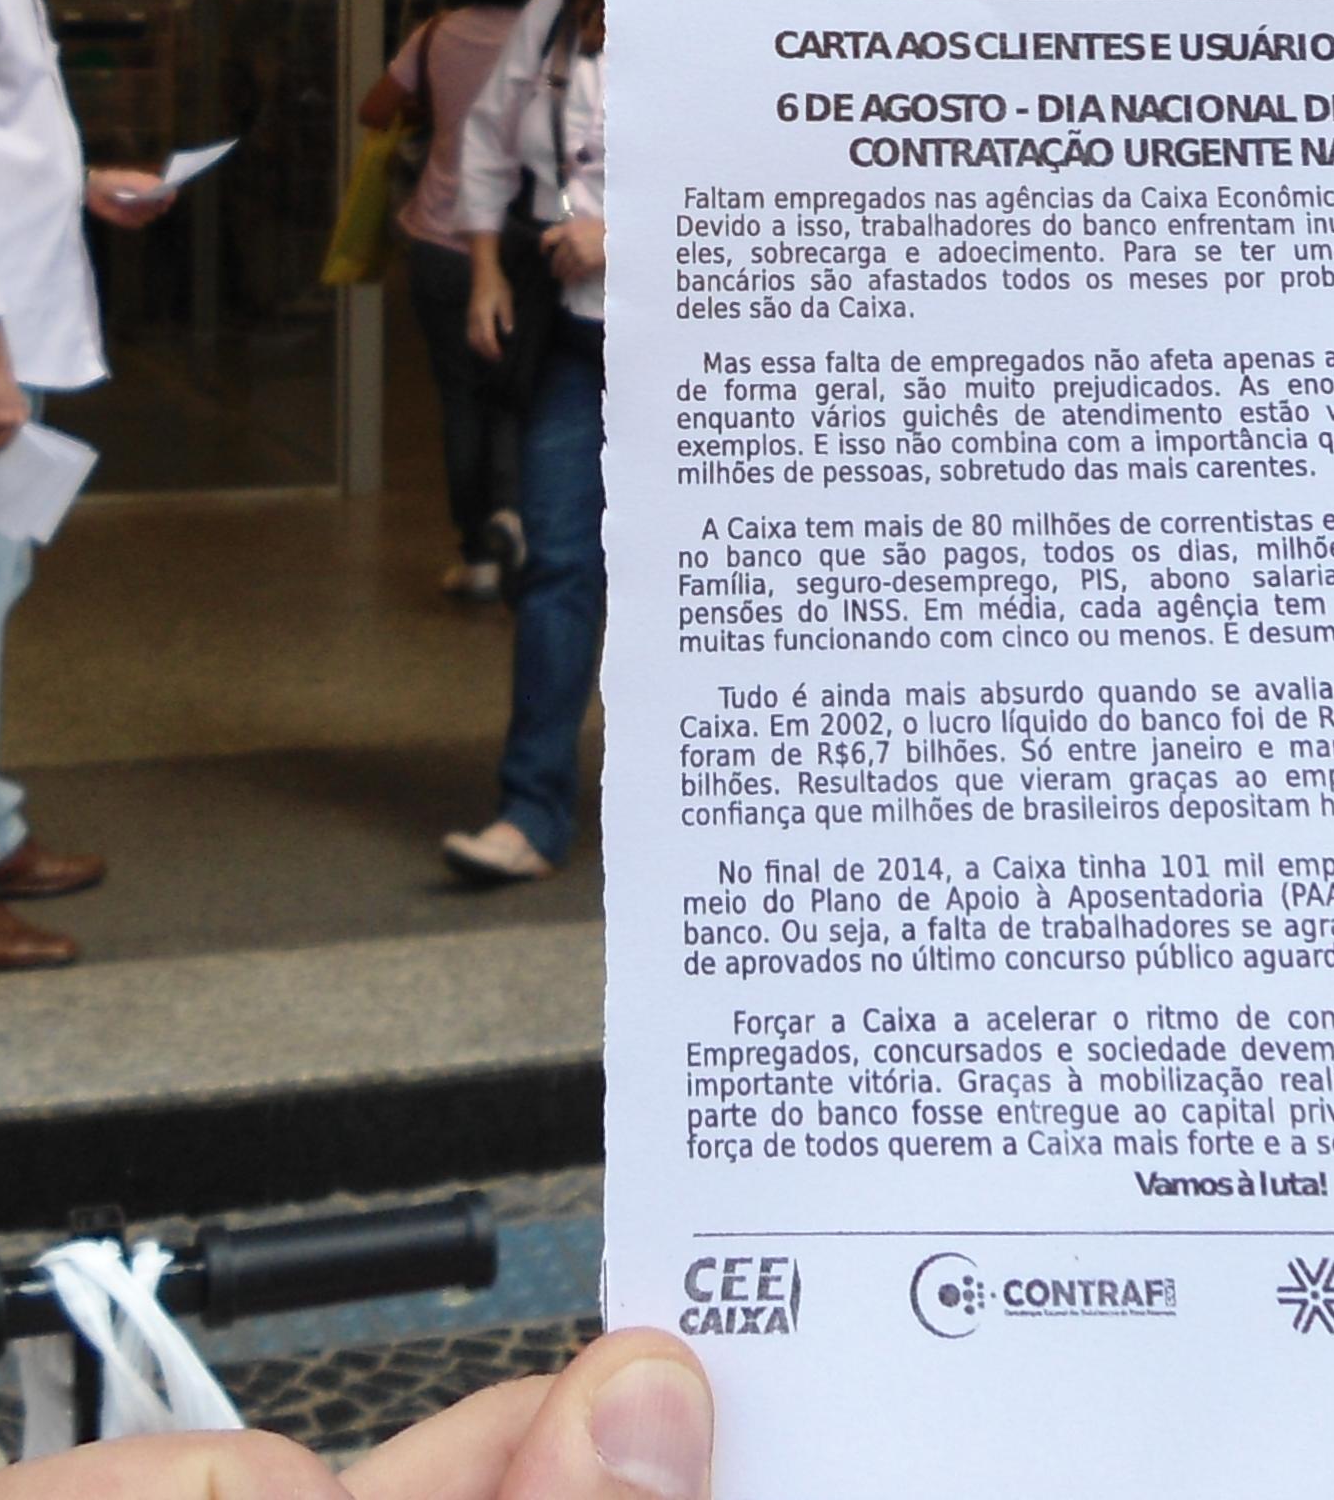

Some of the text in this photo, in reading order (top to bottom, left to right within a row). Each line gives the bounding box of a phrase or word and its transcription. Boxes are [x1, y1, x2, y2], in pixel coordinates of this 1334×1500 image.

[774, 30, 893, 60] CARTA
[895, 31, 972, 61] AOS
[974, 32, 1147, 62] CLIENTES
[1150, 32, 1173, 61] E
[775, 92, 800, 123] 6
[804, 93, 855, 123] DE
[859, 92, 1008, 124] AGOSTO
[1036, 93, 1108, 124] DIA
[1110, 93, 1299, 124] NACIONAL
[848, 128, 1115, 175] CONTRATAÇÃO
[1123, 136, 1294, 168] URGENTE
[684, 185, 765, 210] Faltam
[773, 185, 926, 216] empregados
[934, 191, 978, 210] nas
[985, 184, 1095, 215] agências
[1101, 185, 1132, 210] da
[1140, 184, 1209, 210] Caixa
[676, 212, 762, 238] Devido
[771, 218, 786, 237] a
[796, 212, 851, 241] isso,
[860, 212, 1032, 238] trabalhadores
[1042, 212, 1073, 237] do
[1082, 211, 1158, 237] banco
[1167, 212, 1296, 237] enfrentam
[676, 377, 708, 402] de
[723, 377, 798, 402] forma
[814, 376, 886, 407] geral,
[903, 375, 947, 401] são
[964, 374, 1036, 400] muito
[1052, 373, 1222, 405] prejudicados.
[1238, 373, 1271, 397] As
[677, 454, 1317, 490] milhões de pessoas, sobretudo das mais carentes.
[678, 570, 775, 599] Família,
[795, 568, 1059, 601] seguro-desemprego,
[1080, 567, 1128, 594] PIS,
[1149, 566, 1231, 591] abono
[679, 628, 766, 654] muitas
[772, 624, 932, 652] funcionando
[939, 629, 993, 649] com
[1001, 623, 1070, 649] cinco
[1077, 628, 1110, 648] ou
[1118, 627, 1215, 647] menos.
[1223, 621, 1240, 645] É
[681, 770, 781, 798] bilhões.
[797, 767, 939, 796] Resultados
[955, 772, 1004, 798] que
[1019, 765, 1112, 792] vieram
[1128, 769, 1219, 797] graças
[1235, 769, 1268, 789] ao
[681, 798, 806, 831] confiança
[814, 803, 863, 831] que
[871, 794, 974, 824] milhões
[982, 795, 1015, 822] de
[1022, 793, 1160, 821] brasileiros
[1168, 792, 1311, 826] depositam
[683, 949, 717, 976] de
[725, 946, 862, 982] aprovados
[870, 951, 903, 973] no
[911, 943, 996, 973] último
[1004, 949, 1126, 971] concurso
[1135, 941, 1234, 977] público
[686, 1069, 834, 1104] importante
[847, 1066, 943, 1095] vitória.
[957, 1067, 1052, 1100] Graças
[1066, 1064, 1084, 1093] à
[1099, 1065, 1264, 1099] mobilização
[687, 1101, 758, 1134] parte
[770, 1099, 804, 1128] do
[817, 1098, 899, 1127] banco
[910, 1097, 984, 1126] fosse
[996, 1099, 1120, 1132] entregue
[1133, 1102, 1168, 1125] ao
[1181, 1095, 1276, 1131] capital
[1133, 1168, 1329, 1197] Vamos à luta!
[683, 1256, 790, 1303] CEE
[1002, 1278, 1165, 1307] CONTRAF
[678, 1306, 791, 1336] CAIXA
